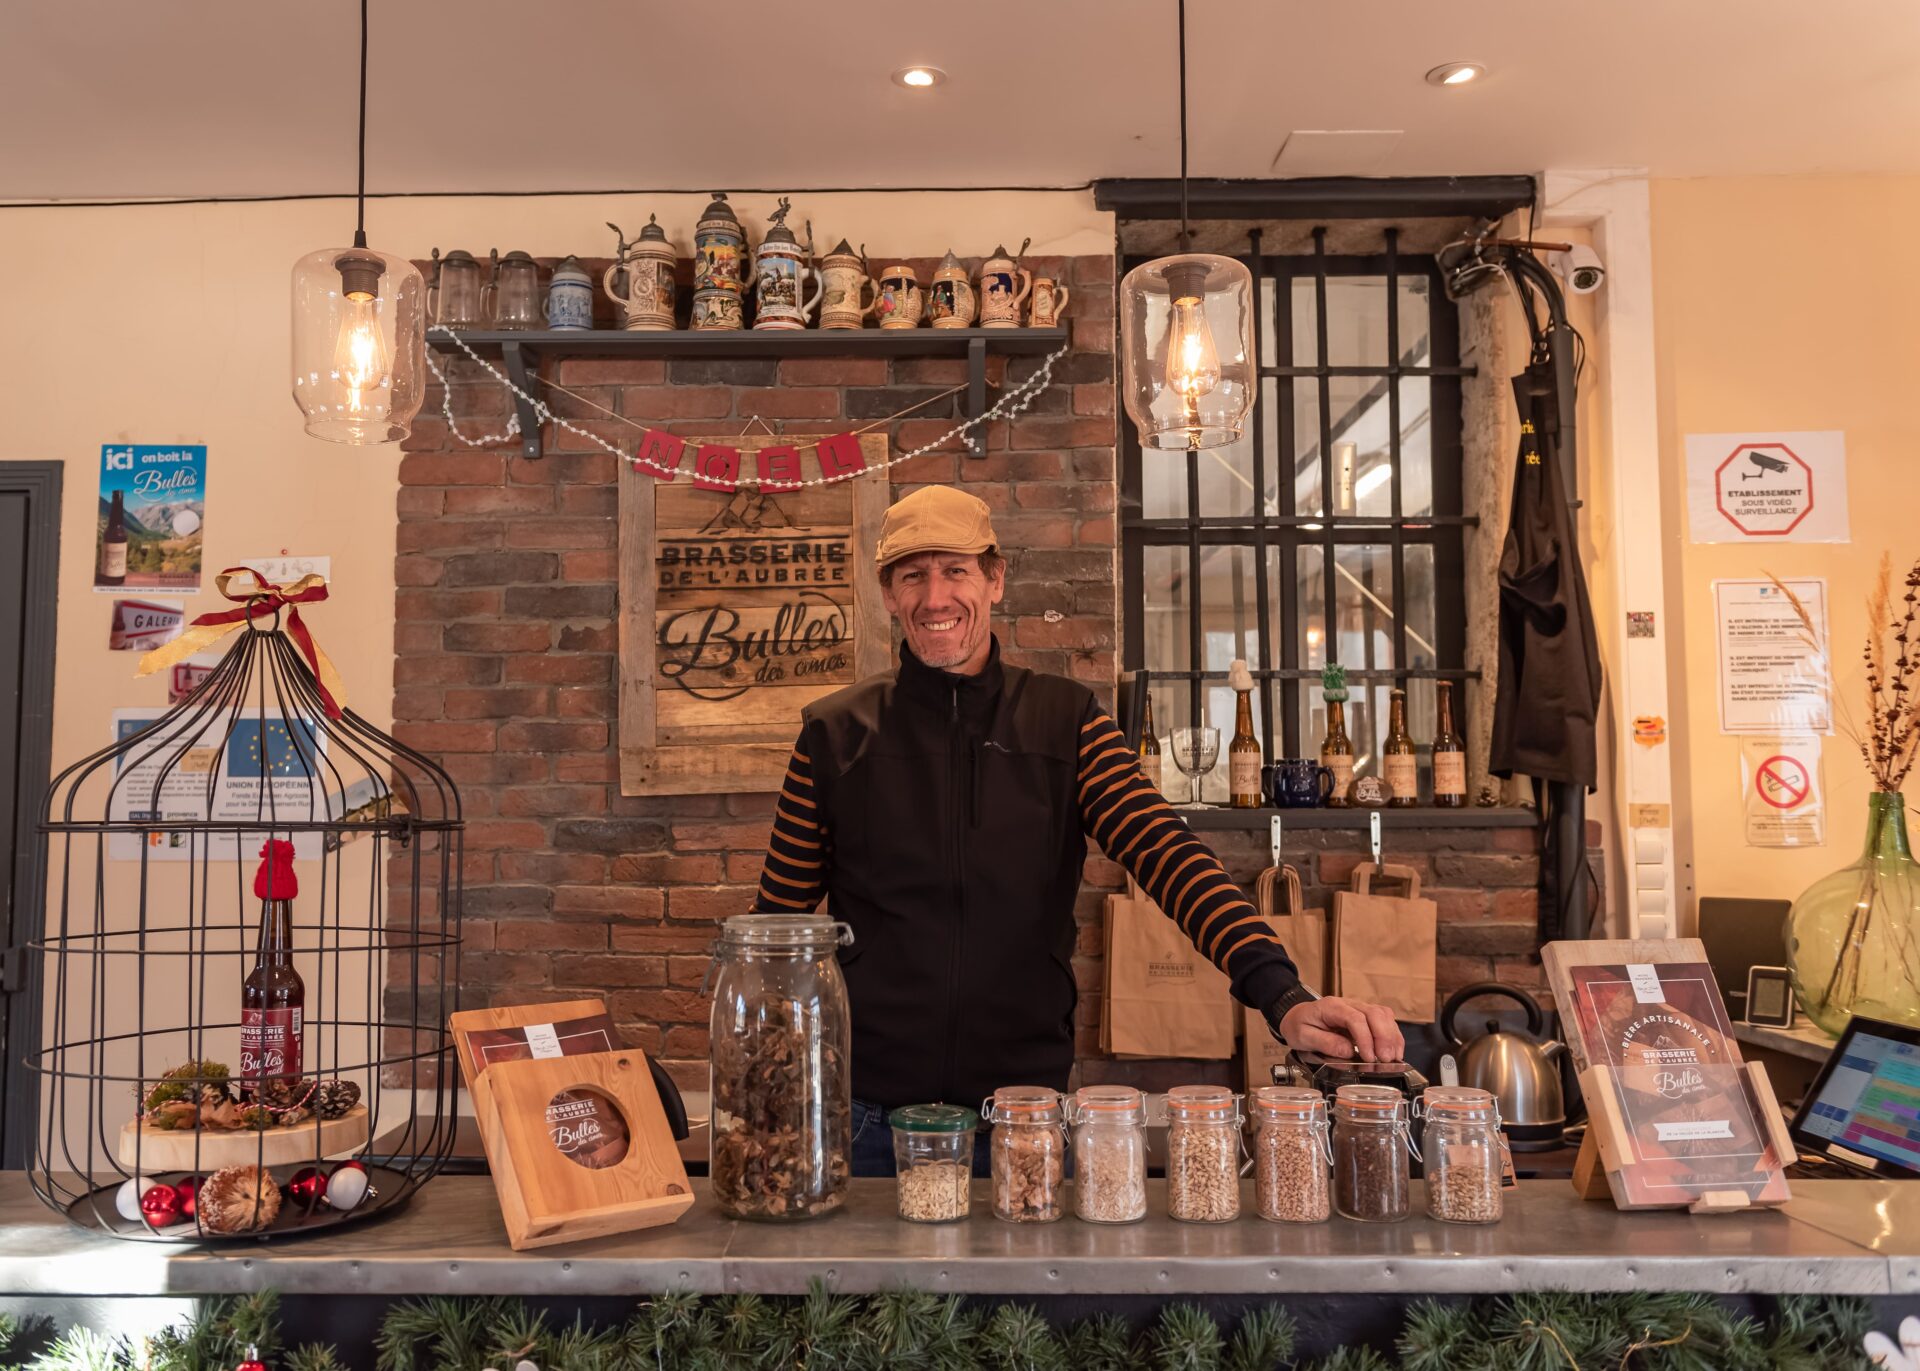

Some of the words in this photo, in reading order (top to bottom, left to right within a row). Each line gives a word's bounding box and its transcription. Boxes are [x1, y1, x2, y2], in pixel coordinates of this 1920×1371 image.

[106, 447, 133, 471] ici
[141, 454, 156, 463] on
[157, 452, 180, 463] boit
[182, 450, 193, 461] la
[133, 467, 197, 497] Bulles
[1728, 489, 1802, 498] ETABLISSEMENT
[1741, 499, 1765, 507] SOUS
[1735, 507, 1798, 516] SURVEILLANCE
[661, 542, 846, 567] BRASSERIE
[660, 571, 693, 585] DE
[708, 565, 845, 585] L'AUBRÉE
[659, 596, 846, 686] Bulles
[755, 658, 785, 683] des
[226, 781, 253, 789] UNION
[256, 780, 313, 789] EUOPÉENN
[241, 1027, 284, 1035] BRASSRIE
[1622, 1021, 1641, 1049] BIÈRE
[1643, 1015, 1711, 1046] ARTISANALE
[1642, 1050, 1697, 1059] BRASSERIE
[1653, 1069, 1704, 1095] Bulles
[545, 1101, 595, 1115] RASSERIE
[549, 1120, 600, 1149] Bulles
